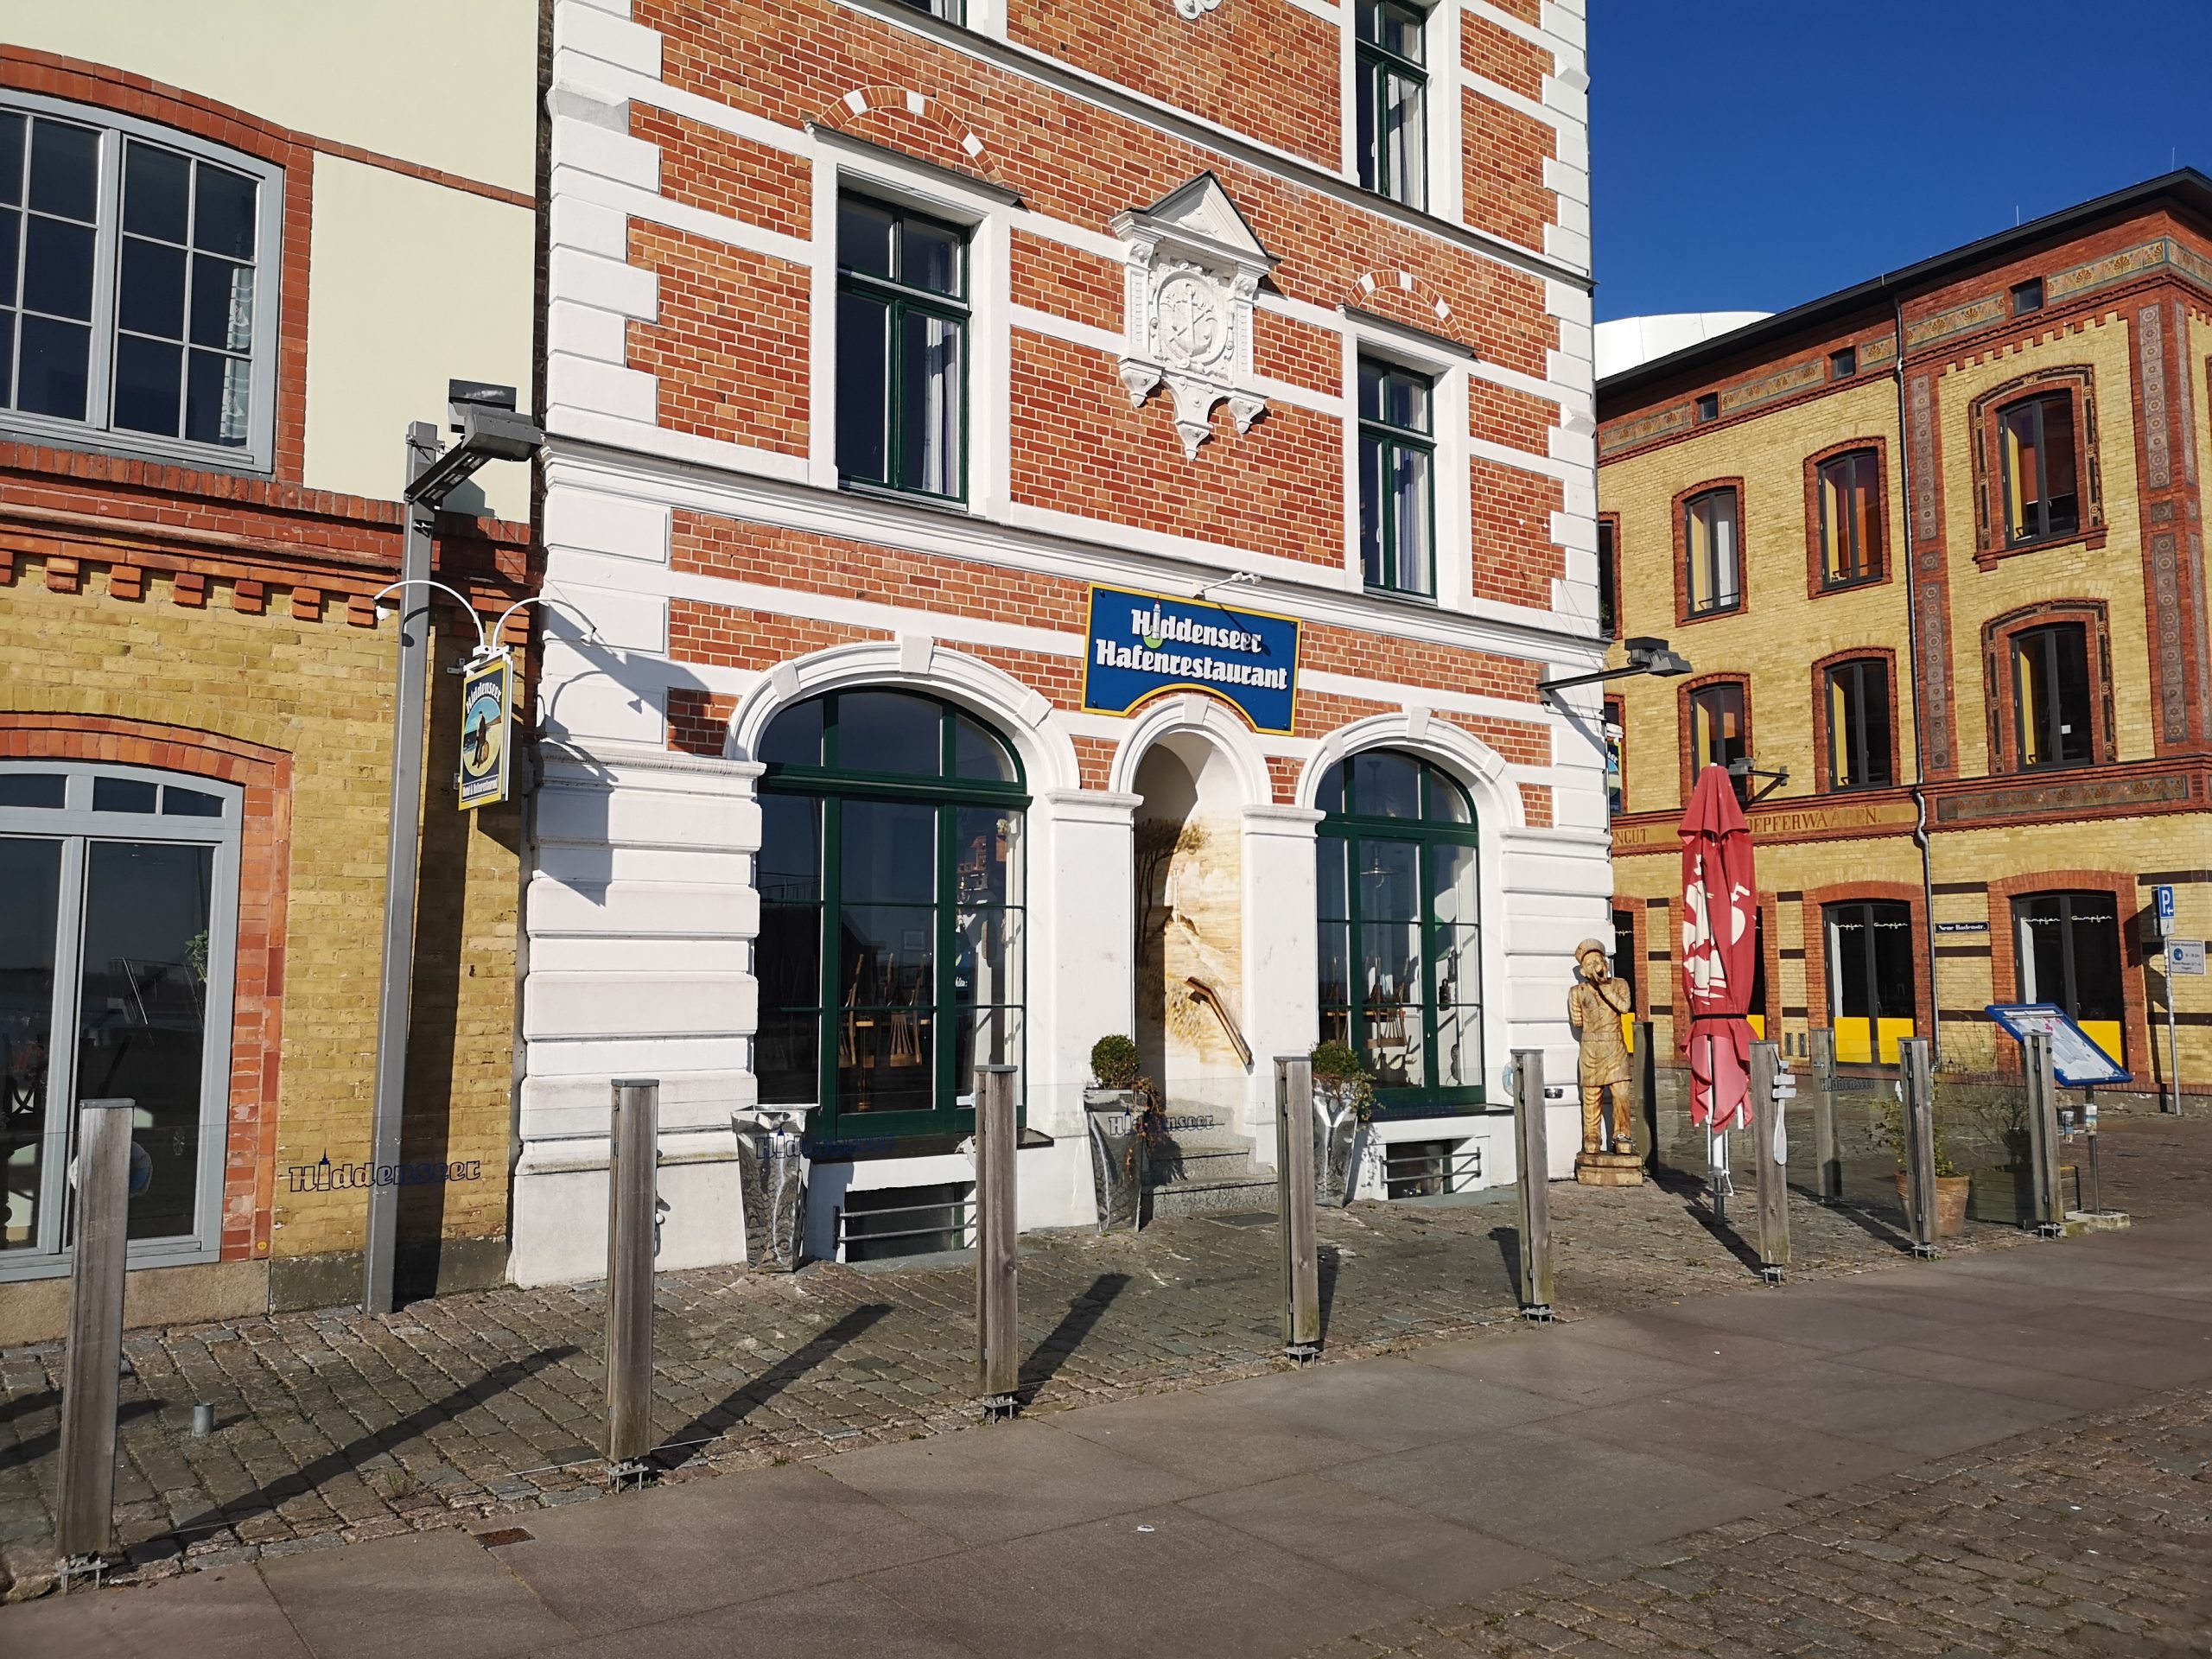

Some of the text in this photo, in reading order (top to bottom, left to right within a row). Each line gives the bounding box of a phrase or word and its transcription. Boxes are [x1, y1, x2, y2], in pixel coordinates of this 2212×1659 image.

[1131, 600, 1262, 653] Hiddenseer
[1096, 639, 1287, 690] Hafenrestaurant
[2161, 889, 2171, 914] P
[289, 1152, 480, 1192] Hiddenseer
